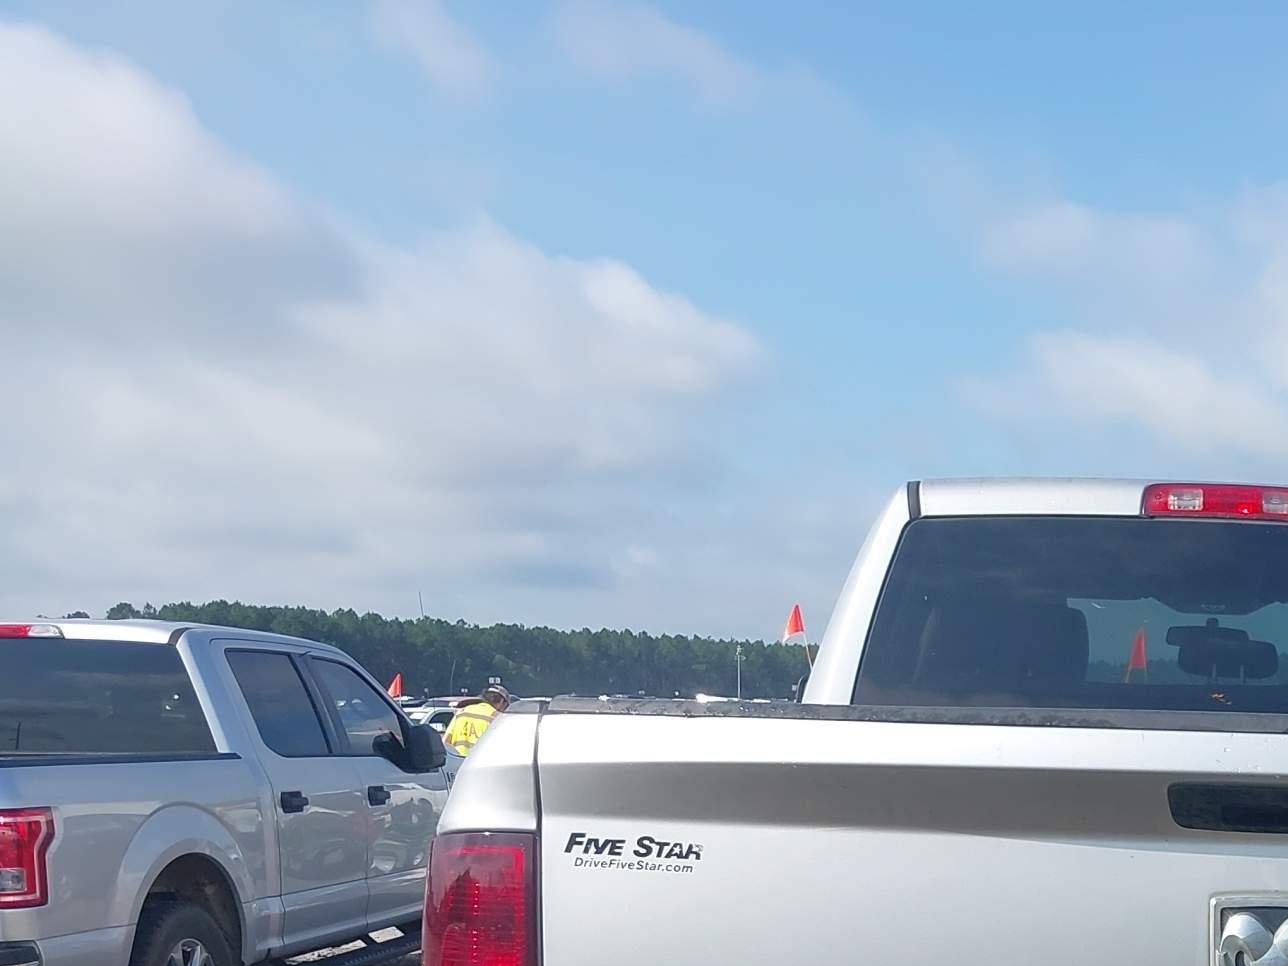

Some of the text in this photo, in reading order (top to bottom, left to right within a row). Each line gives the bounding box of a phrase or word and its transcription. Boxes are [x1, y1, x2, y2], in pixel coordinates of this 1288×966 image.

[564, 832, 704, 860] FIVE STAR
[573, 857, 693, 873] DriveFiveStar.com
